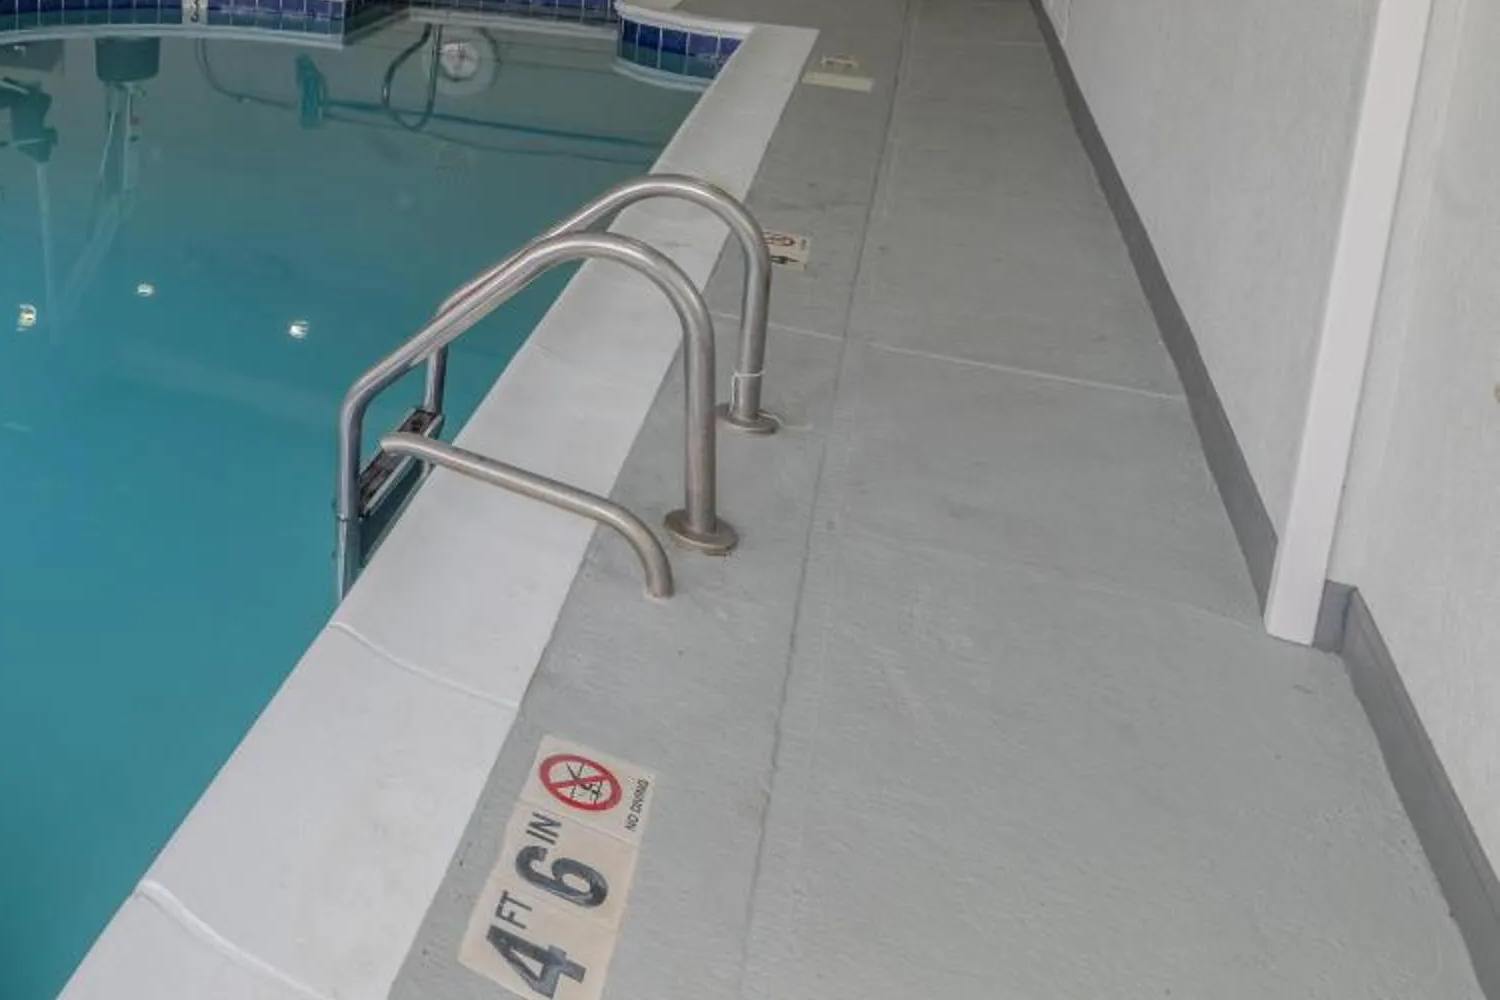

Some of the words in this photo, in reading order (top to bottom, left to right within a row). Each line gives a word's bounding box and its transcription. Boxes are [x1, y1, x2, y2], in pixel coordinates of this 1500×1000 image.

[629, 779, 649, 814] DIVING
[526, 811, 562, 845] IN
[624, 813, 639, 832] NO
[515, 845, 609, 908] 6
[495, 890, 533, 930] FT
[486, 924, 587, 1000] 4
